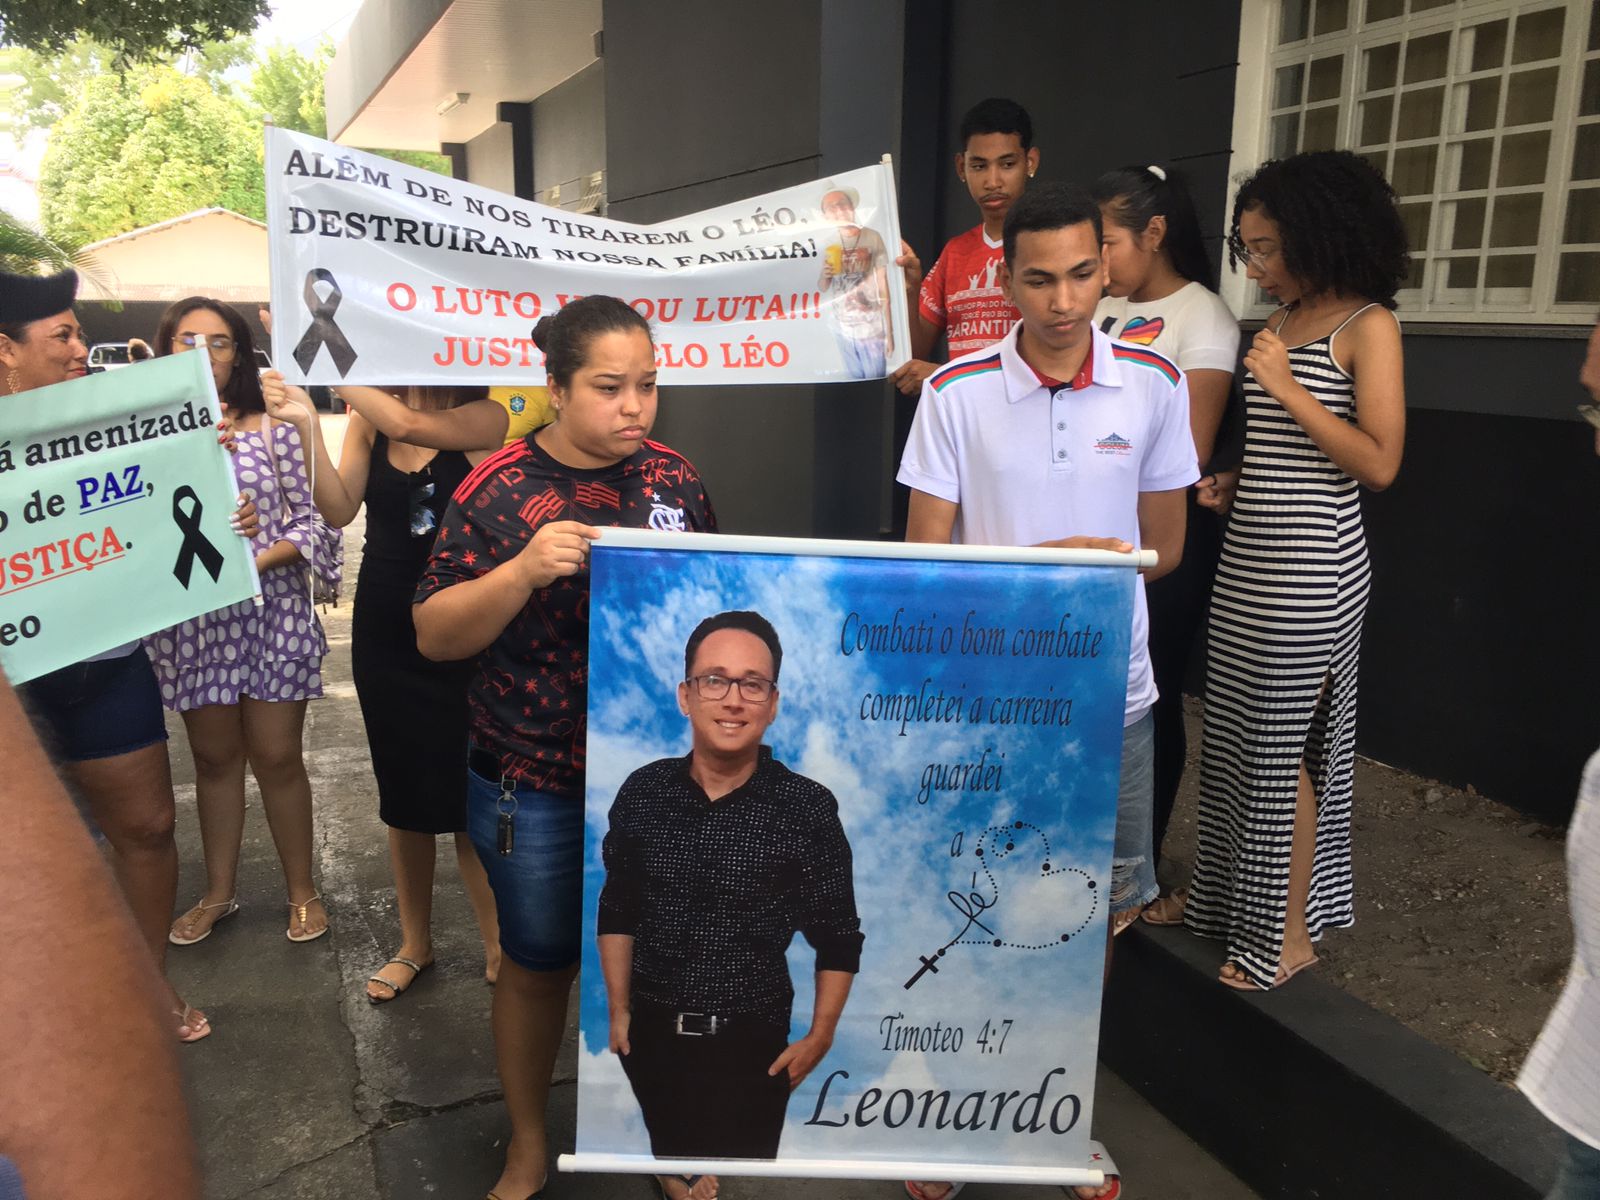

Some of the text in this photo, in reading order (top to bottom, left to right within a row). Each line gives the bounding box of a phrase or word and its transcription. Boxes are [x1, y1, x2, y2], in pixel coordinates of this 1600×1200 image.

[284, 148, 807, 245] ALÉM DE NOS TIRAREM O LÉO,
[289, 206, 818, 269] DESTRUIRAM NOSSA FAMÍLIA!
[386, 282, 417, 312] O
[432, 285, 541, 319] LUTO
[693, 292, 821, 322] LUTA!!!
[720, 335, 790, 368] LÉO
[25, 401, 213, 467] amenizada
[24, 489, 65, 524] de
[77, 464, 154, 512] PAZ,
[840, 607, 1104, 659] Combati o bom combate
[860, 677, 1073, 737] completei a carreira
[917, 747, 1006, 805] guardei
[950, 830, 965, 857] a
[879, 1011, 1014, 1055] Timoteo 4:7
[803, 1066, 1082, 1136] Leonardo
